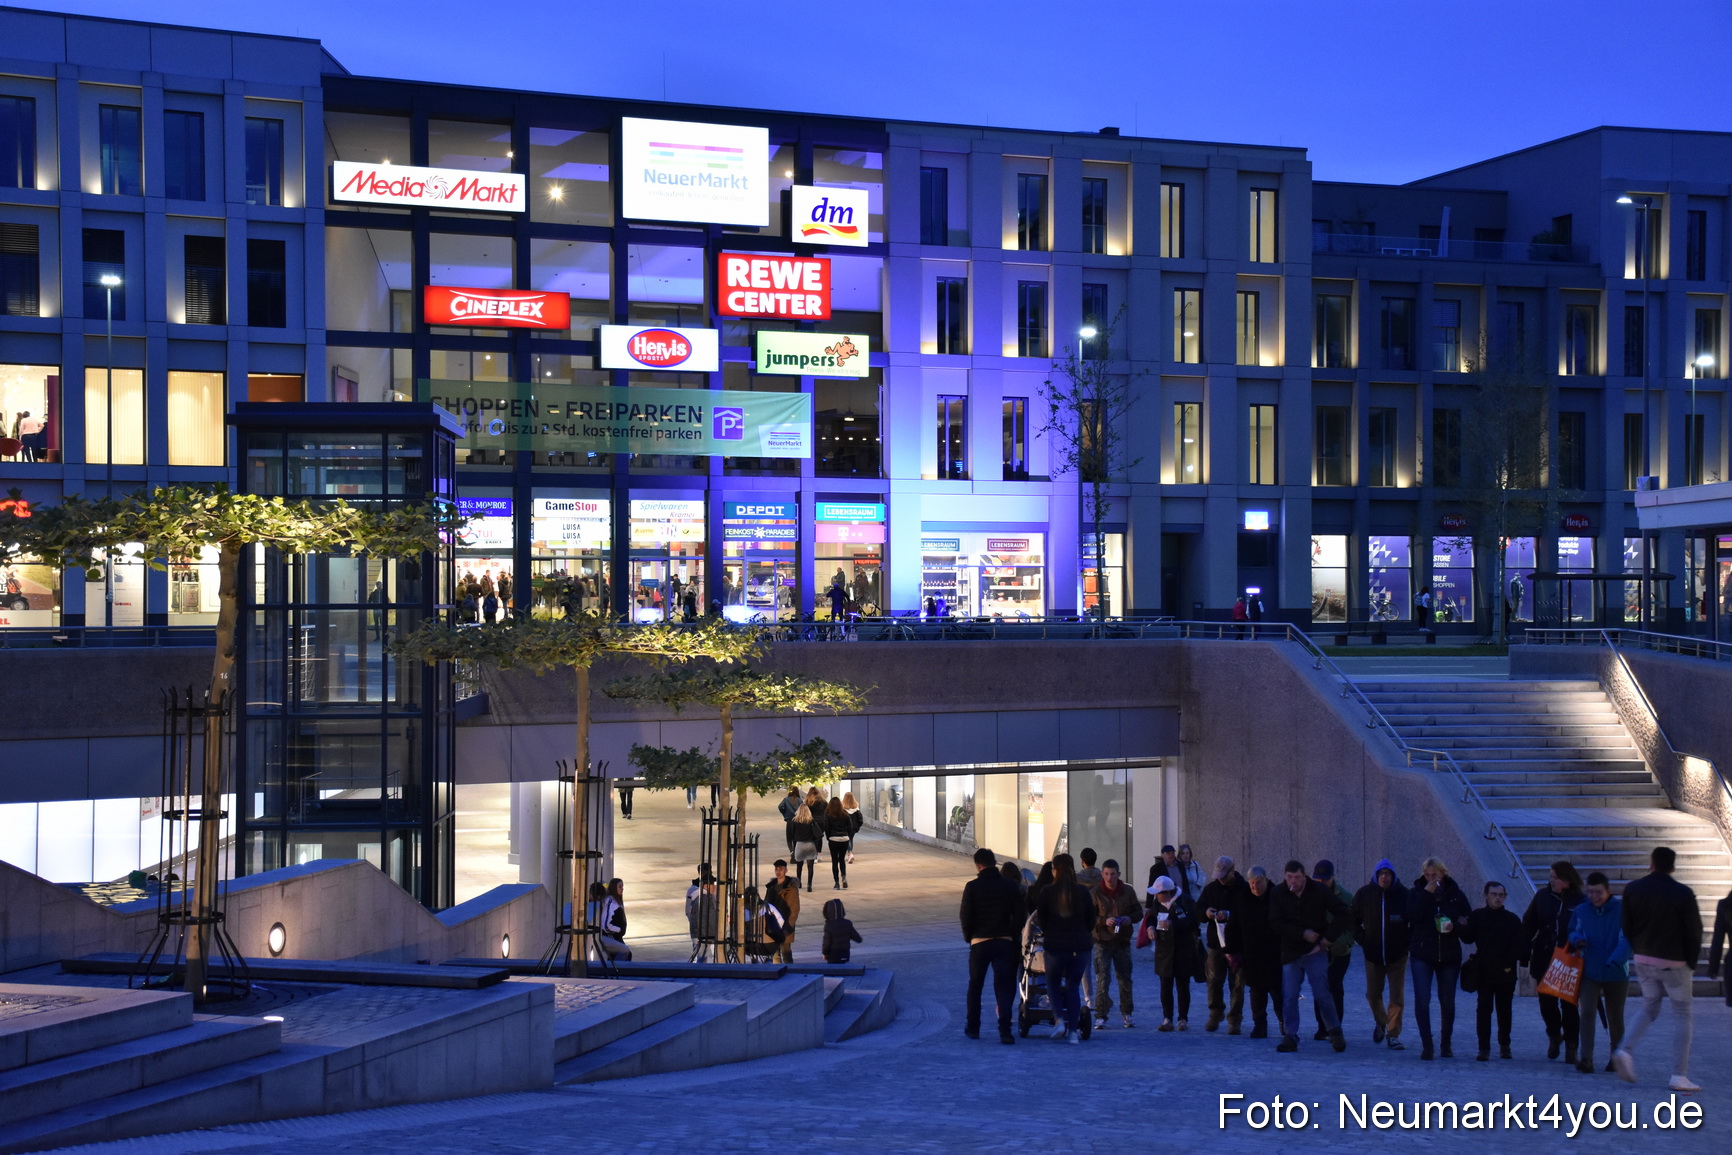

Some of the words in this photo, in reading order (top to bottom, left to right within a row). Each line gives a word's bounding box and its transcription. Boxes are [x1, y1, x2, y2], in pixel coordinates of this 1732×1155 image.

[341, 170, 425, 197] Media
[445, 177, 518, 203] Markt
[643, 168, 749, 190] NeuerMarkt
[811, 197, 854, 224] dm
[727, 258, 823, 291] REWE
[450, 296, 545, 318] CINEPLEX
[727, 290, 823, 316] CENTER
[634, 336, 687, 360] Hervis
[765, 349, 835, 370] jumpers
[565, 401, 703, 423] FREIPARKEN
[521, 425, 538, 435] zu
[552, 422, 580, 437] Std.
[582, 423, 653, 438] kostenfrei
[656, 427, 702, 442] parken
[475, 501, 507, 510] MONROE
[545, 501, 598, 513] GameStop
[639, 501, 689, 511] Spielwaren
[736, 505, 785, 515] DEPOT
[827, 508, 874, 516] LEBENSRAUM
[562, 523, 581, 531] LUISA
[765, 528, 795, 536] PARADIES
[1566, 517, 1589, 528] Hervis
[562, 532, 581, 540] LUISA
